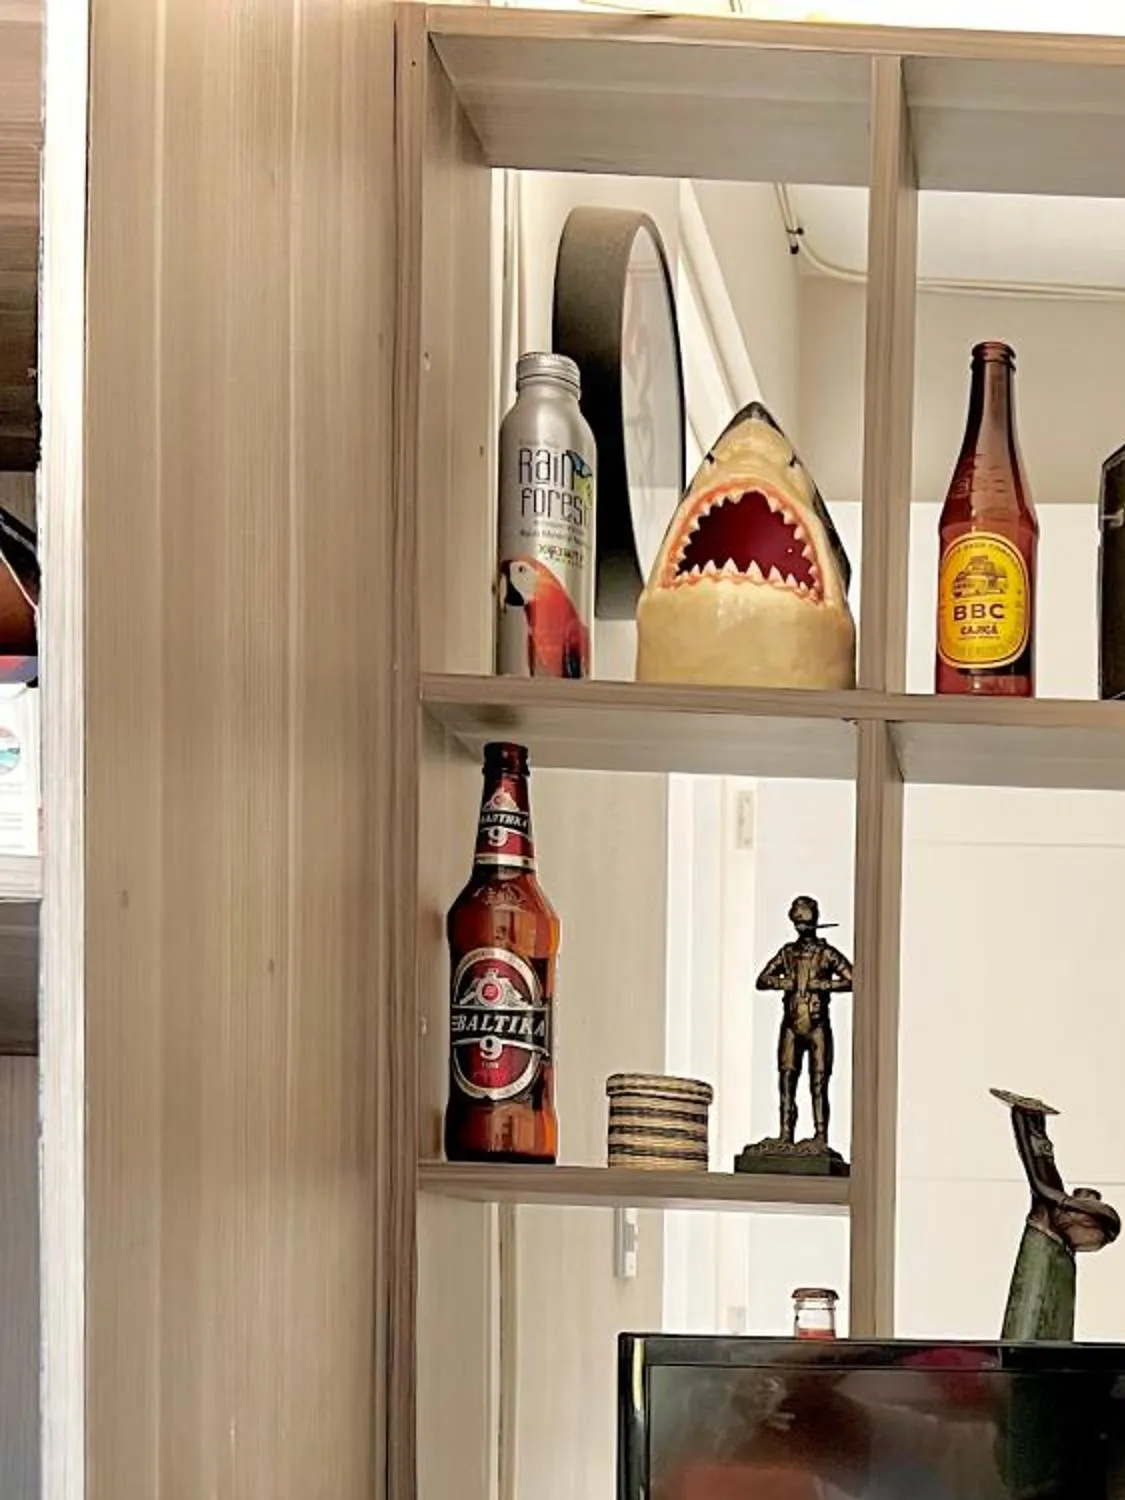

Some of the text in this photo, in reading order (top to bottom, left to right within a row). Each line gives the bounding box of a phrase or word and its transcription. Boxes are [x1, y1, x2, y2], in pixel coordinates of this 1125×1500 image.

[953, 603, 1005, 621] BBC
[487, 825, 509, 848] 9
[452, 1012, 546, 1038] BALTIKA
[479, 1035, 503, 1061] 9
